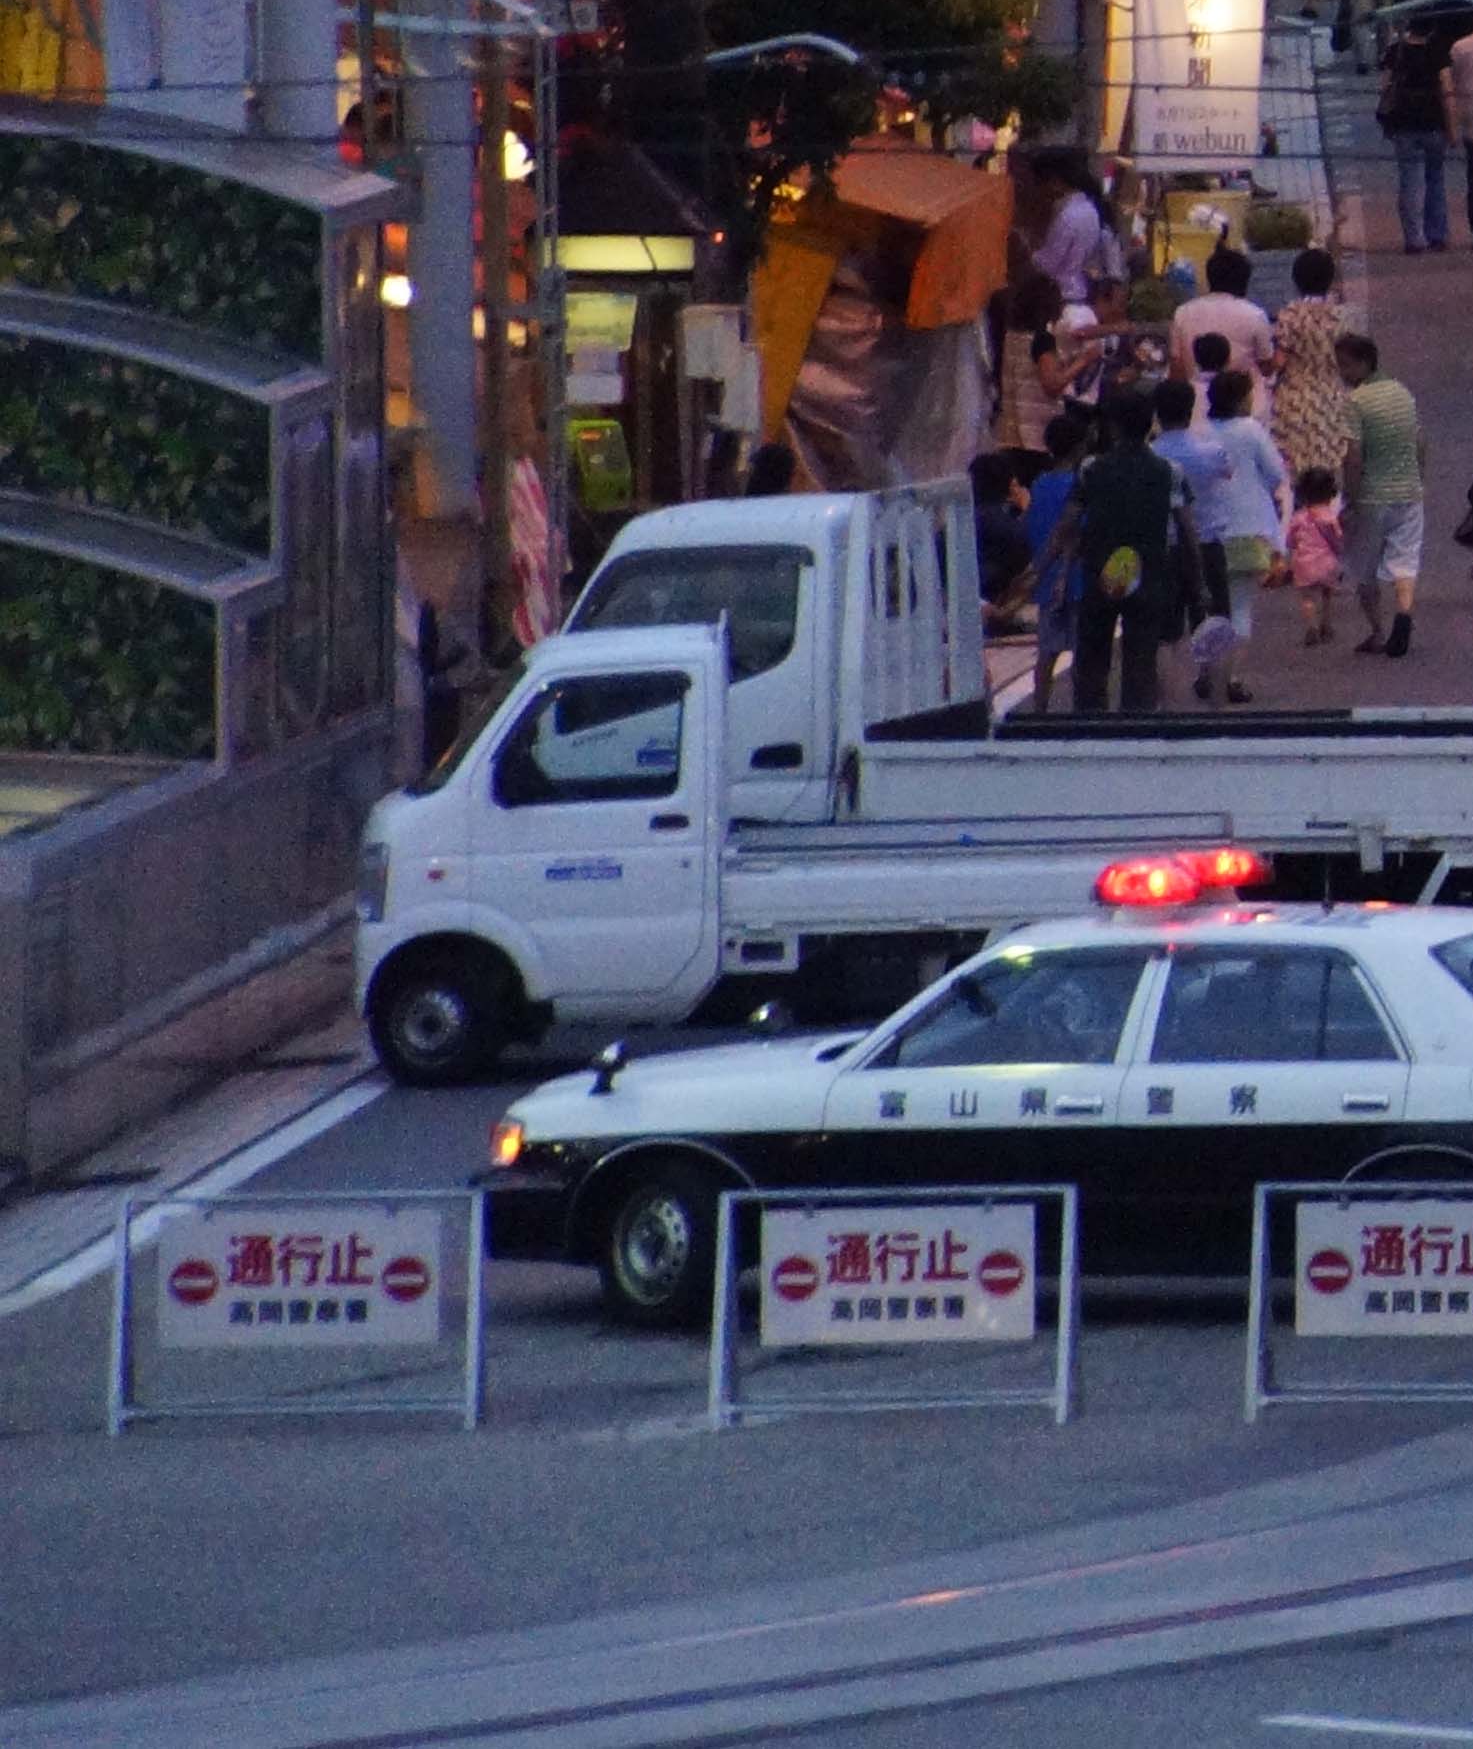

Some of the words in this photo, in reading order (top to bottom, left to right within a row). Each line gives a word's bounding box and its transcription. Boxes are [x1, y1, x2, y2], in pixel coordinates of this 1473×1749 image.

[227, 1234, 374, 1288] 通行止
[824, 1230, 968, 1286] 通行止
[230, 1300, 370, 1325] 高岡警察署
[831, 1297, 965, 1322] 高岡警察署
